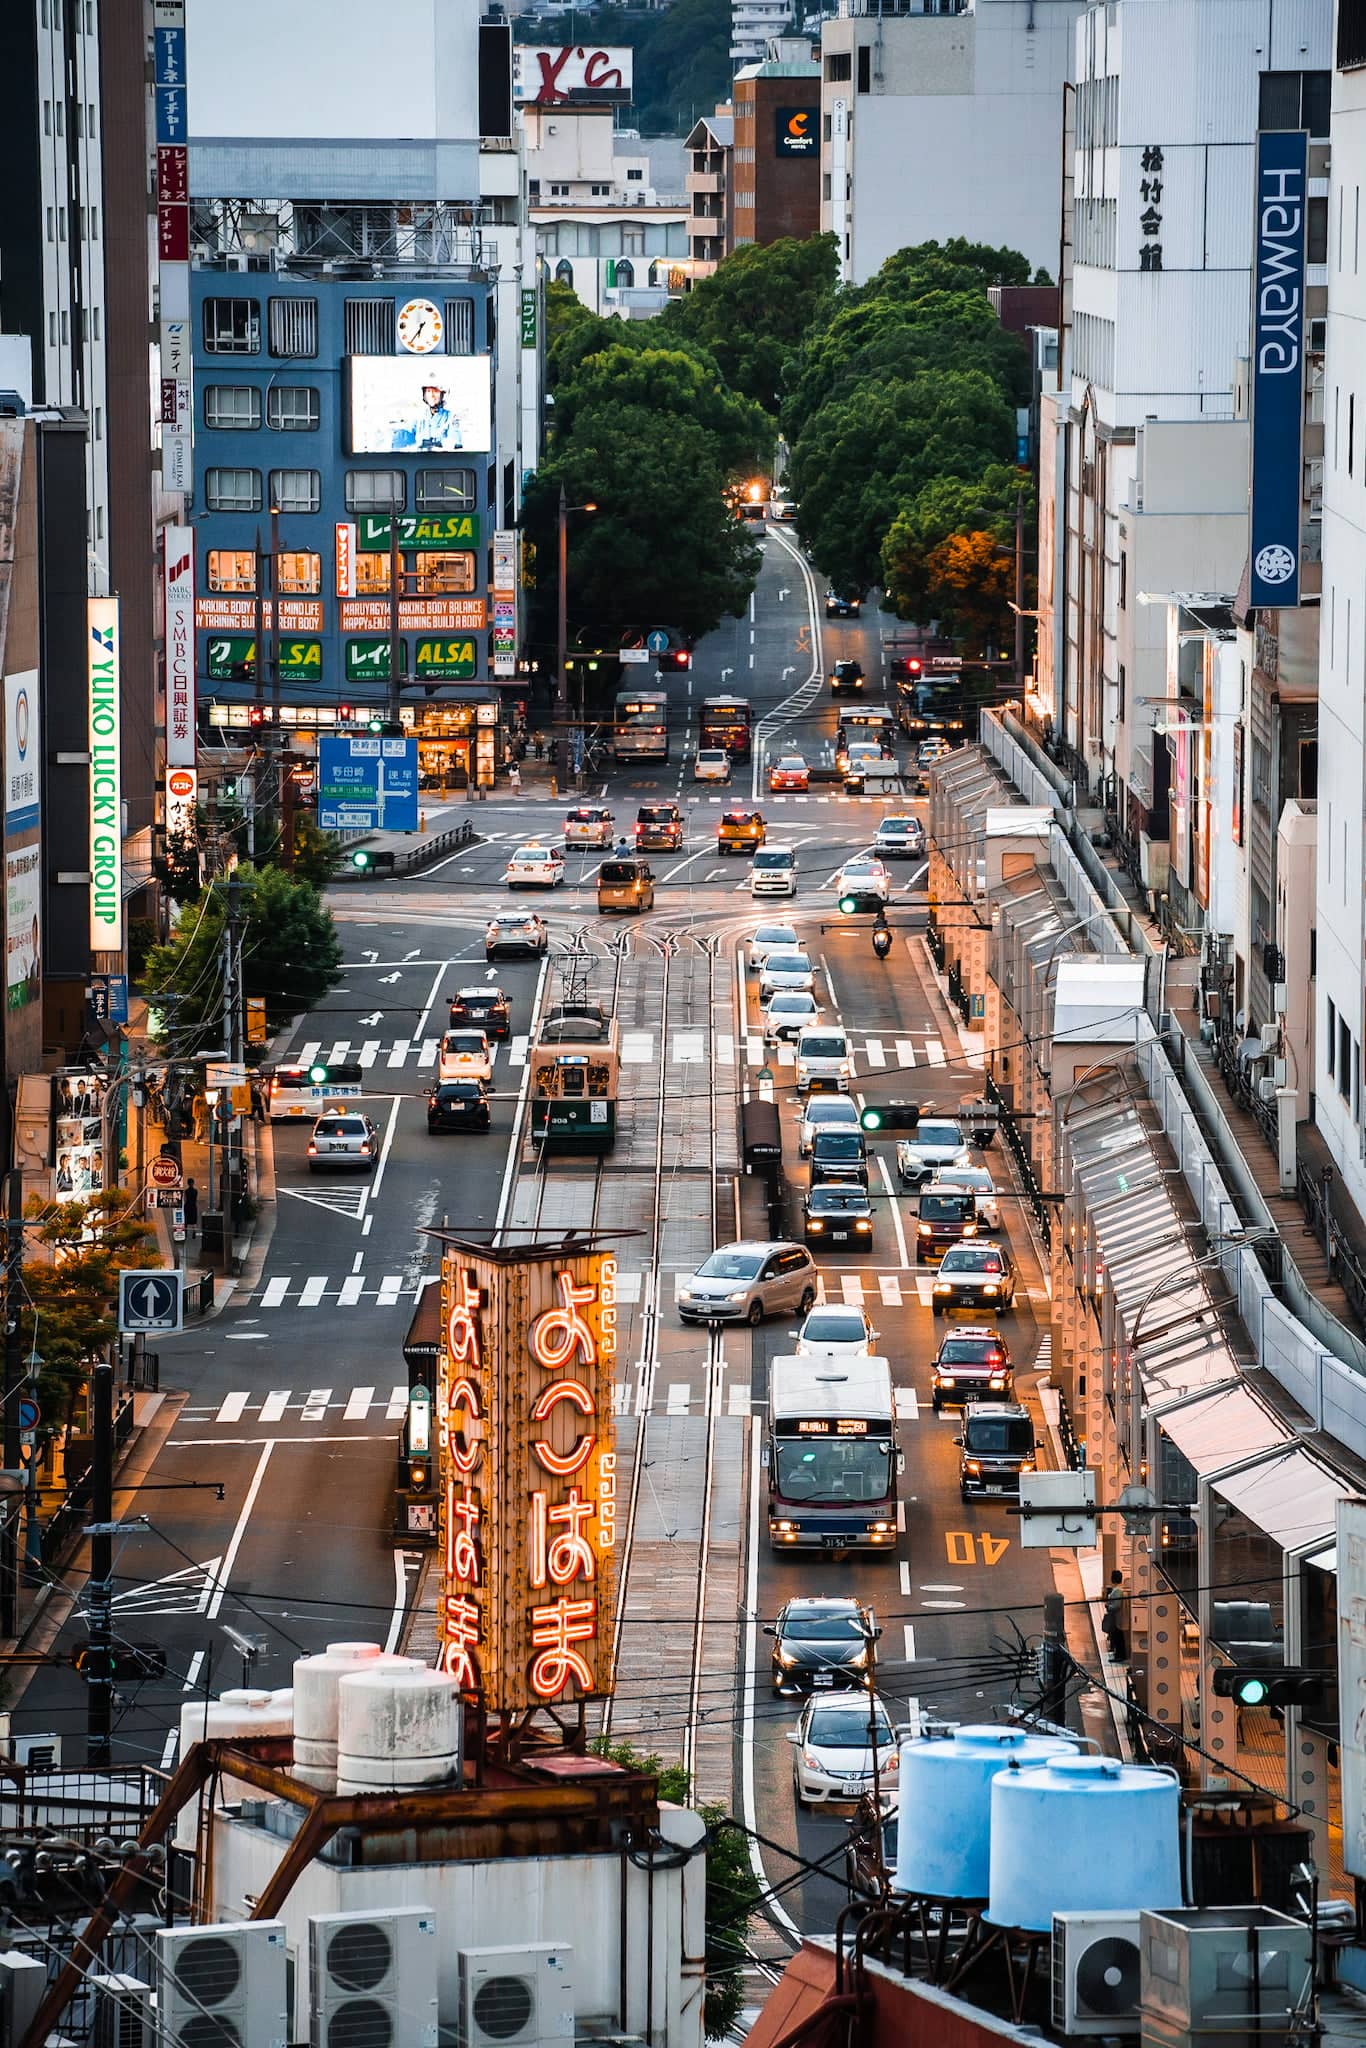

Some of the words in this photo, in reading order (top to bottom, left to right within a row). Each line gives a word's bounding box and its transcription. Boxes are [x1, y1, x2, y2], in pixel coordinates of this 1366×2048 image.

[163, 31, 179, 136] アートネイチャー
[783, 137, 813, 145] Comfort
[174, 150, 186, 200] レディース
[160, 149, 172, 254] アートネイチャー
[170, 336, 181, 373] ニチイ
[170, 425, 183, 433] 6F
[415, 517, 473, 538] ALSA
[339, 543, 348, 592] アイフル
[200, 600, 229, 613] MAKING
[230, 600, 251, 614] BODY
[205, 615, 240, 628] TRAINING
[241, 616, 259, 629] BUI
[278, 617, 296, 630] REAT
[298, 617, 320, 630] BODY
[343, 617, 391, 630] HAPPY&ENJO
[432, 616, 455, 629] BUILD
[461, 615, 483, 628] BODY
[426, 601, 447, 614] BODY
[449, 600, 483, 613] BALANCE
[173, 610, 189, 739] SMBC日興証券
[417, 642, 473, 664] ALSA
[92, 660, 114, 736] YUKO
[93, 745, 116, 828] LUCKY
[94, 836, 116, 925] GROUP
[446, 1267, 482, 1702] よこはま
[529, 1270, 597, 1698] よこはま
[945, 1532, 1010, 1565] 40
